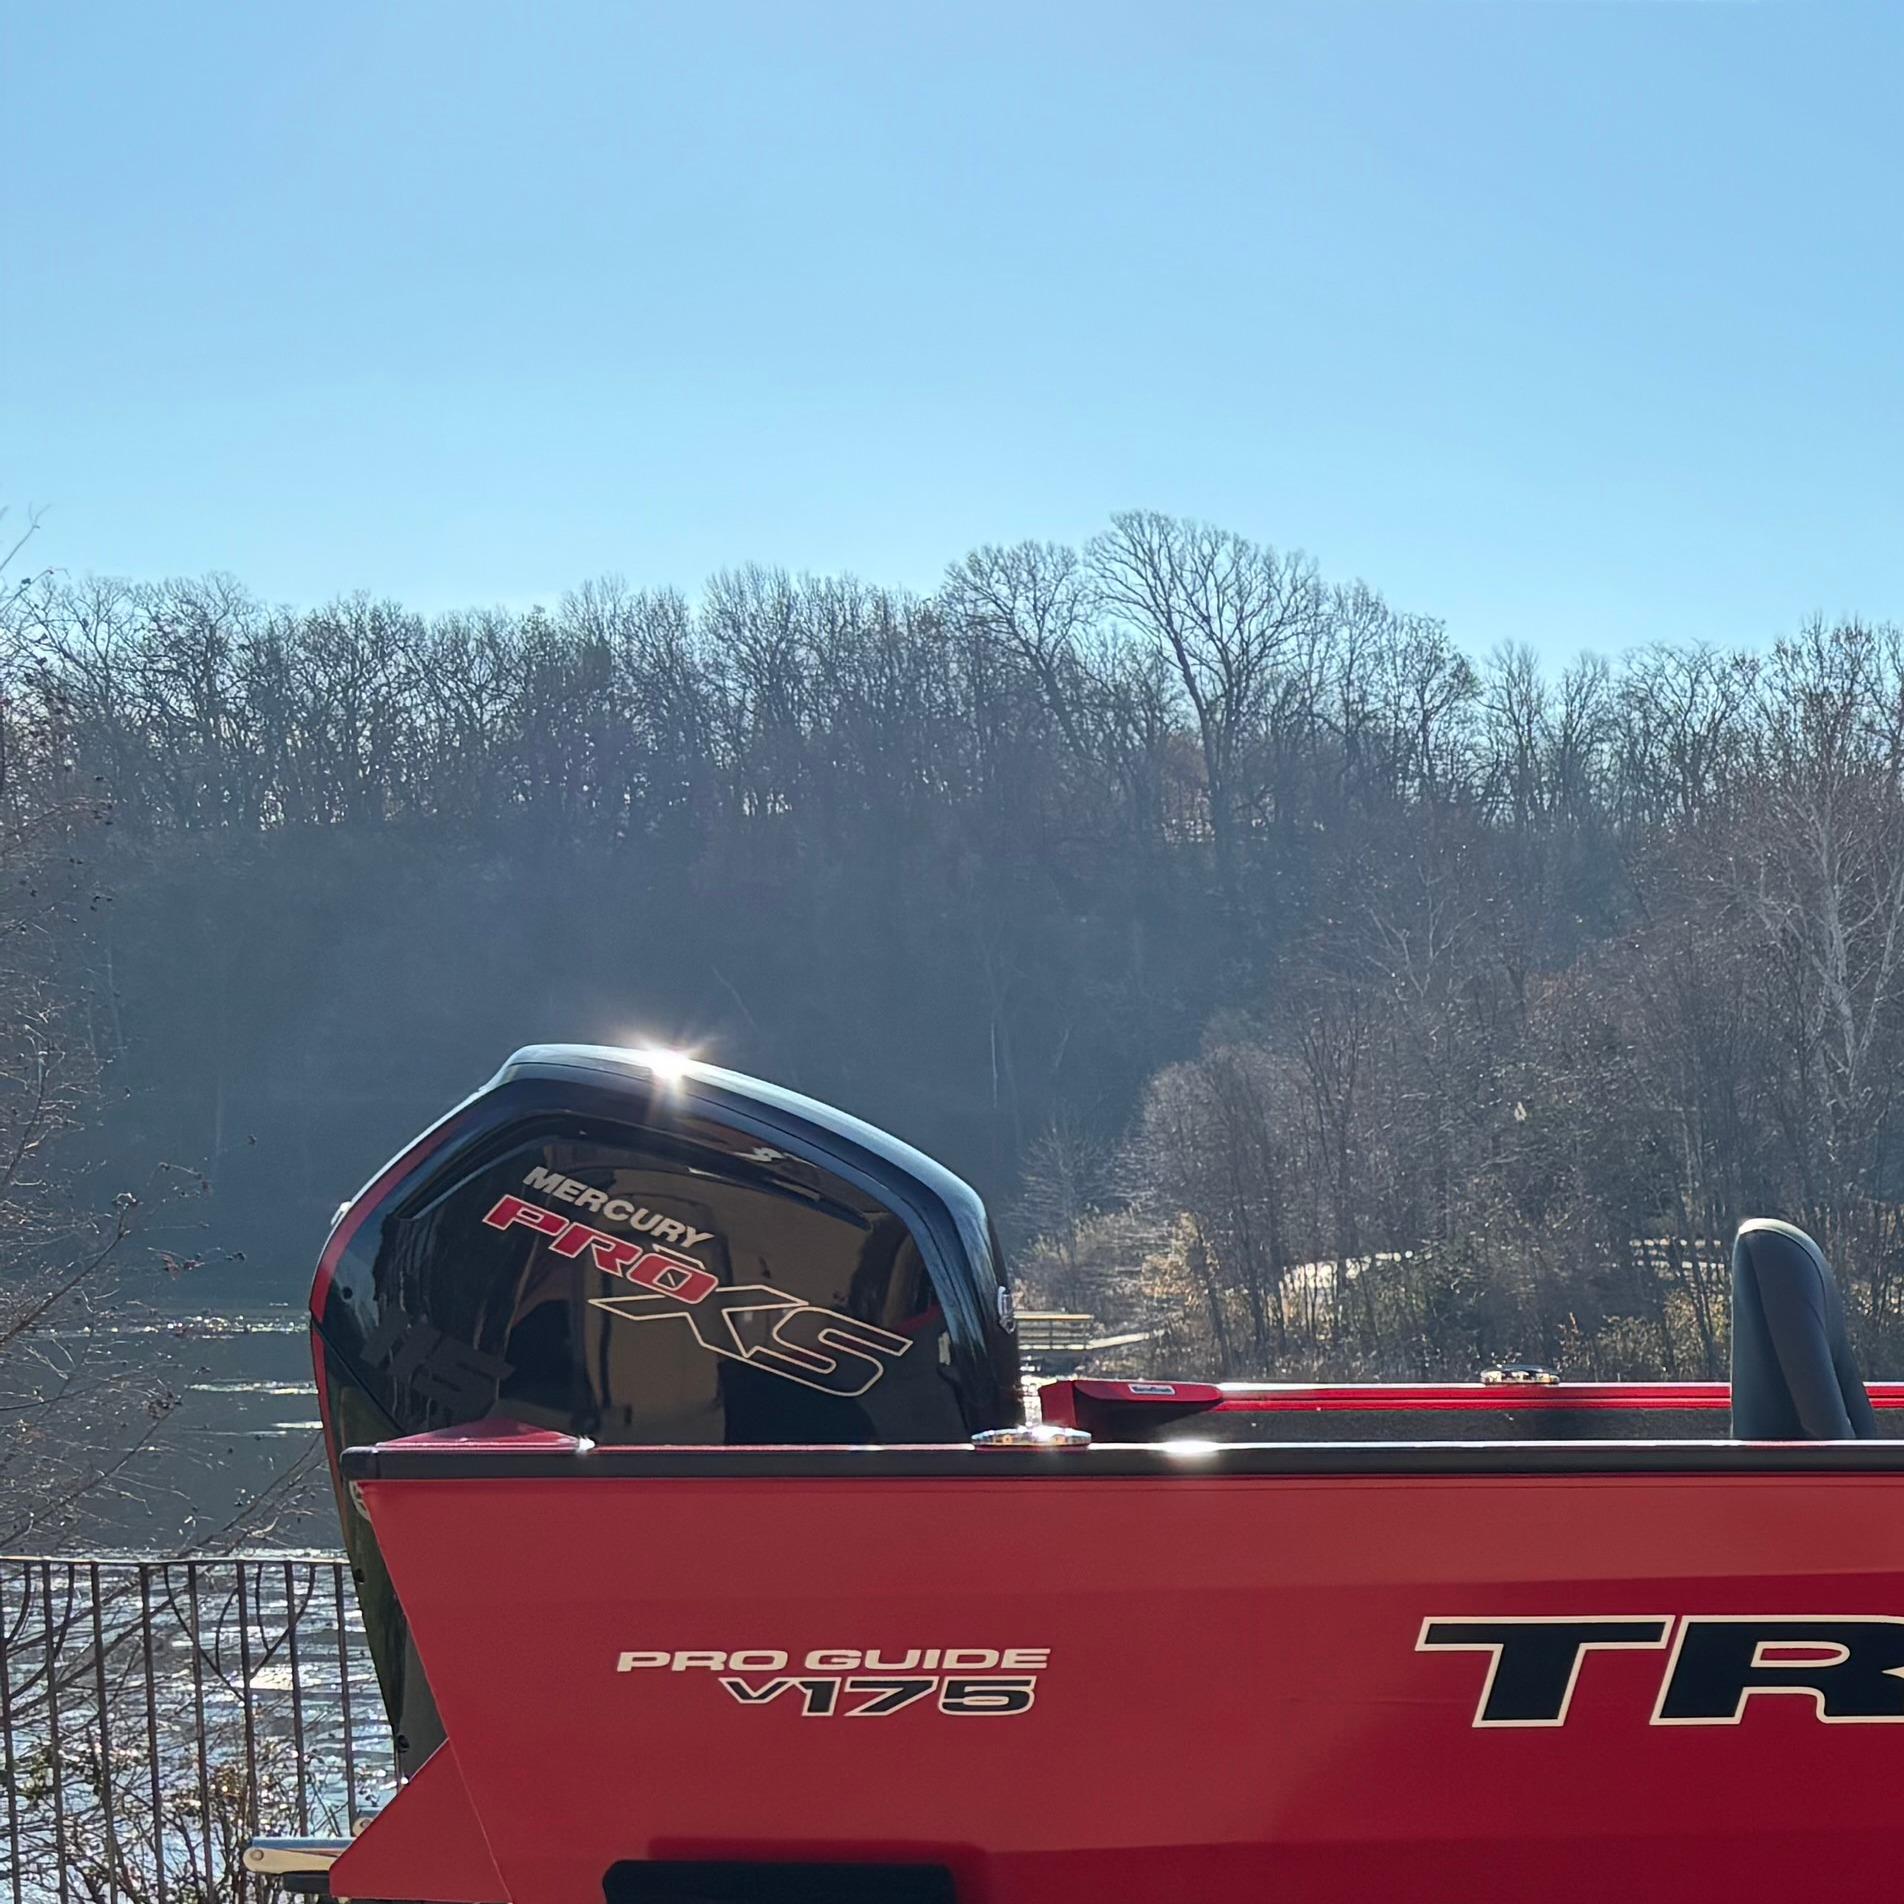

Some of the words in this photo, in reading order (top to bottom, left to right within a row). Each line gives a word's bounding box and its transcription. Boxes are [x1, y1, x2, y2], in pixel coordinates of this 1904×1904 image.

[481, 1193, 720, 1305] PRO
[523, 1165, 715, 1249] MERCURY
[587, 1244, 914, 1398] XS
[616, 1648, 789, 1672] PRO
[804, 1647, 1052, 1670] GUIDE
[718, 1674, 1038, 1717] V175
